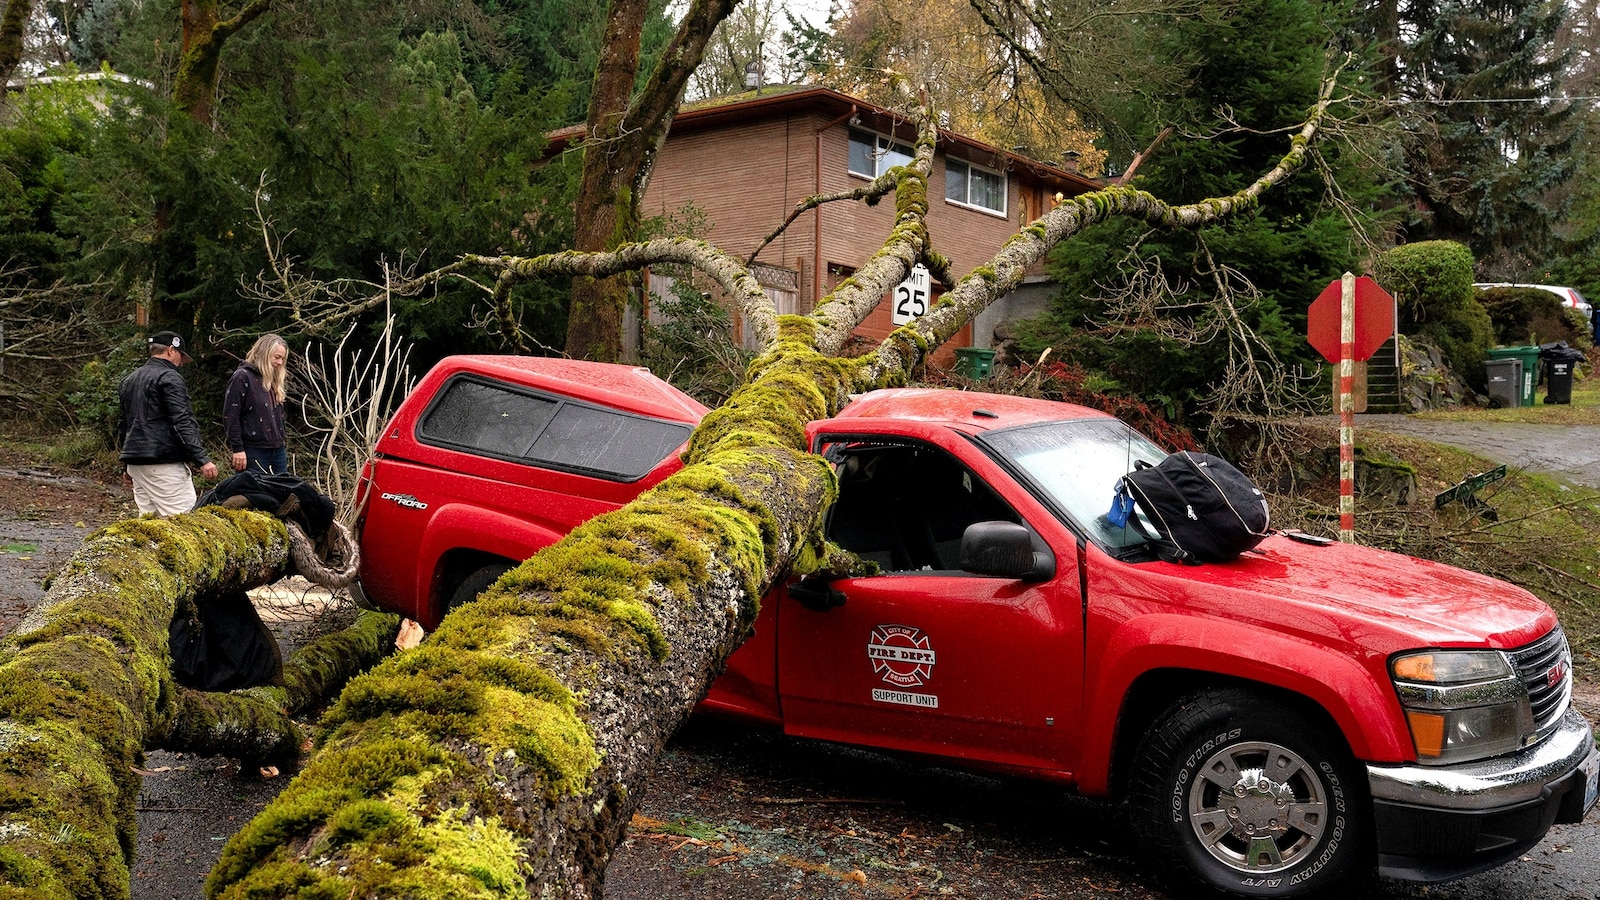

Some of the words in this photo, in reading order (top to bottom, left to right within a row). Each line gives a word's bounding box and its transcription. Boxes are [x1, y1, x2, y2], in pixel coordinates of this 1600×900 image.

[906, 272, 924, 285] MIT
[896, 286, 925, 318] 25
[381, 493, 402, 501] OFF
[398, 499, 428, 509] ROAD
[869, 647, 896, 658] FIRE
[900, 650, 934, 663] DEPT.
[889, 673, 916, 683] SEATTLE
[873, 690, 913, 704] SUPPORT
[915, 695, 936, 706] UNIT
[1172, 768, 1189, 823] TOYO
[1186, 728, 1242, 768] TIRES
[1319, 761, 1346, 812] OPEN
[1289, 815, 1346, 886] COUNTRY
[1241, 877, 1283, 888] A/T
